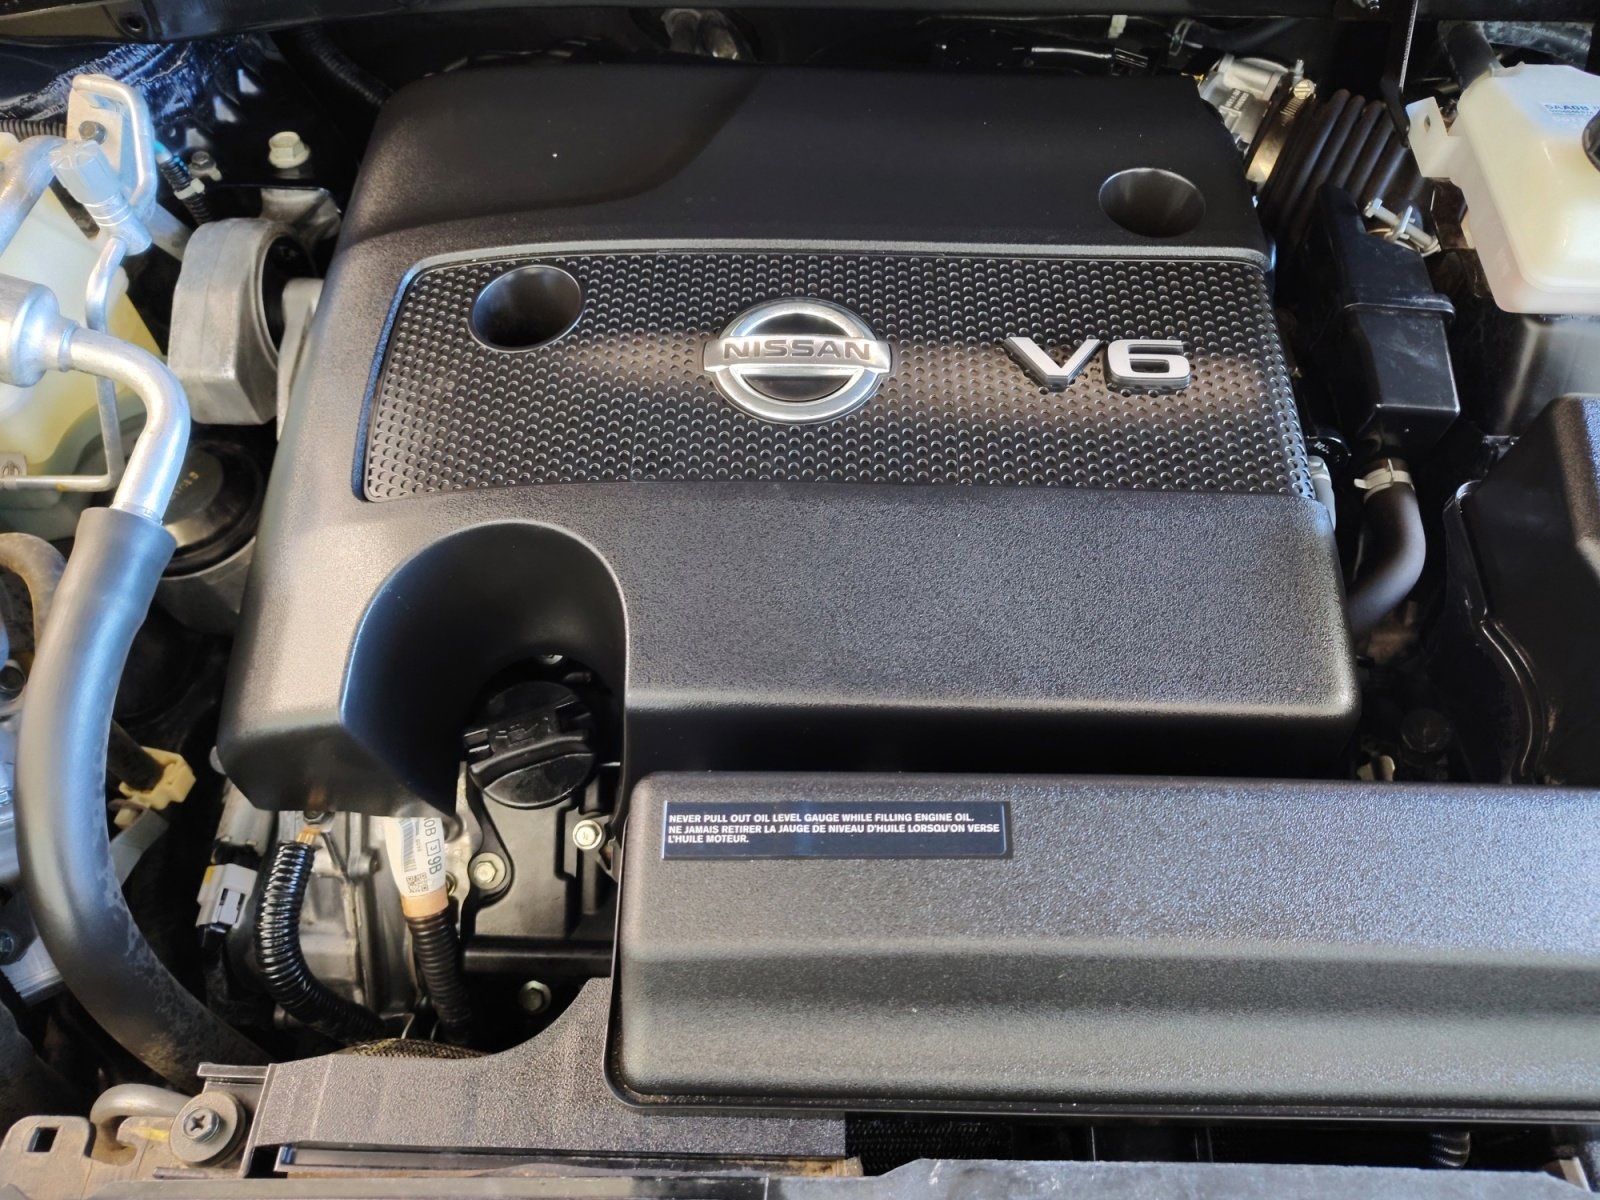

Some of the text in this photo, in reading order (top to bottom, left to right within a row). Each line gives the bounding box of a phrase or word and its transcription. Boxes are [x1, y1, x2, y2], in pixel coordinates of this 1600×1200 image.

[723, 339, 871, 361] NISSAN
[1004, 336, 1191, 392] V6
[424, 817, 436, 836] 0B
[669, 813, 974, 823] NEVER PULL OUT OIL LEVEL GAUGE WHILE FILLING ENGINE OIL.
[668, 824, 1000, 834] NE JAMAIS RETIRER LA JAUGE DE NIVEAU D'HUILE LORSQU'ON VERSE
[668, 834, 749, 844] L'HUILE MOTEUR.
[428, 855, 443, 875] 9B
